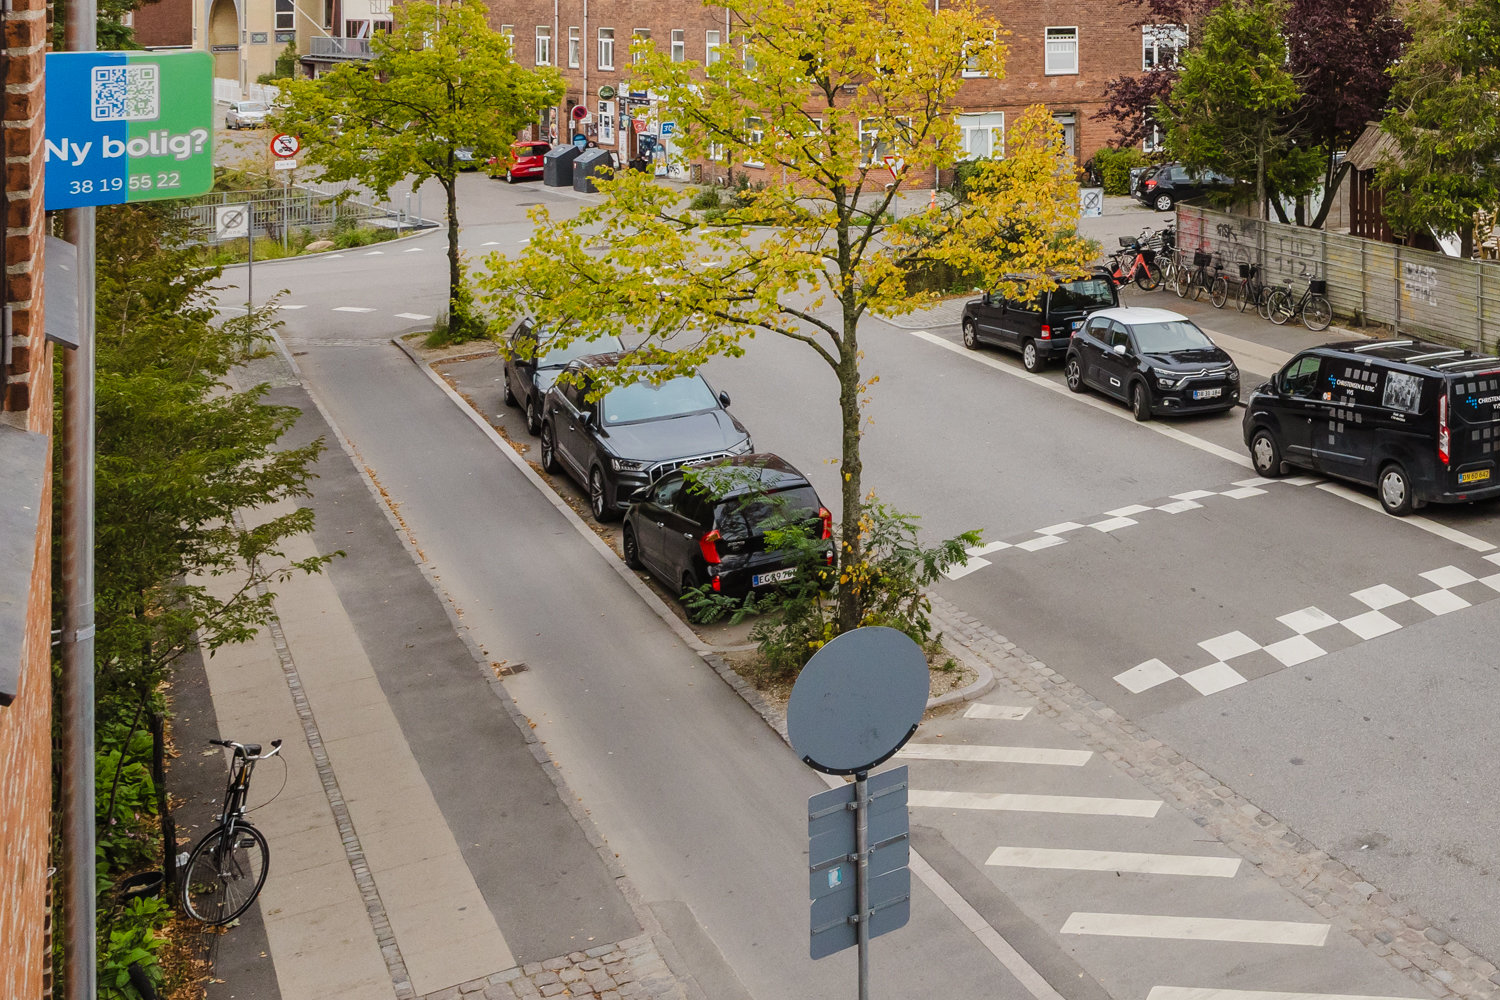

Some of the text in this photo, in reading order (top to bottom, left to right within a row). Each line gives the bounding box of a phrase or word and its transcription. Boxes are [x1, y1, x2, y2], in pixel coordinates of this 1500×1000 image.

[45, 128, 209, 167] Ny bolig?
[69, 172, 181, 195] 38 19 55 22
